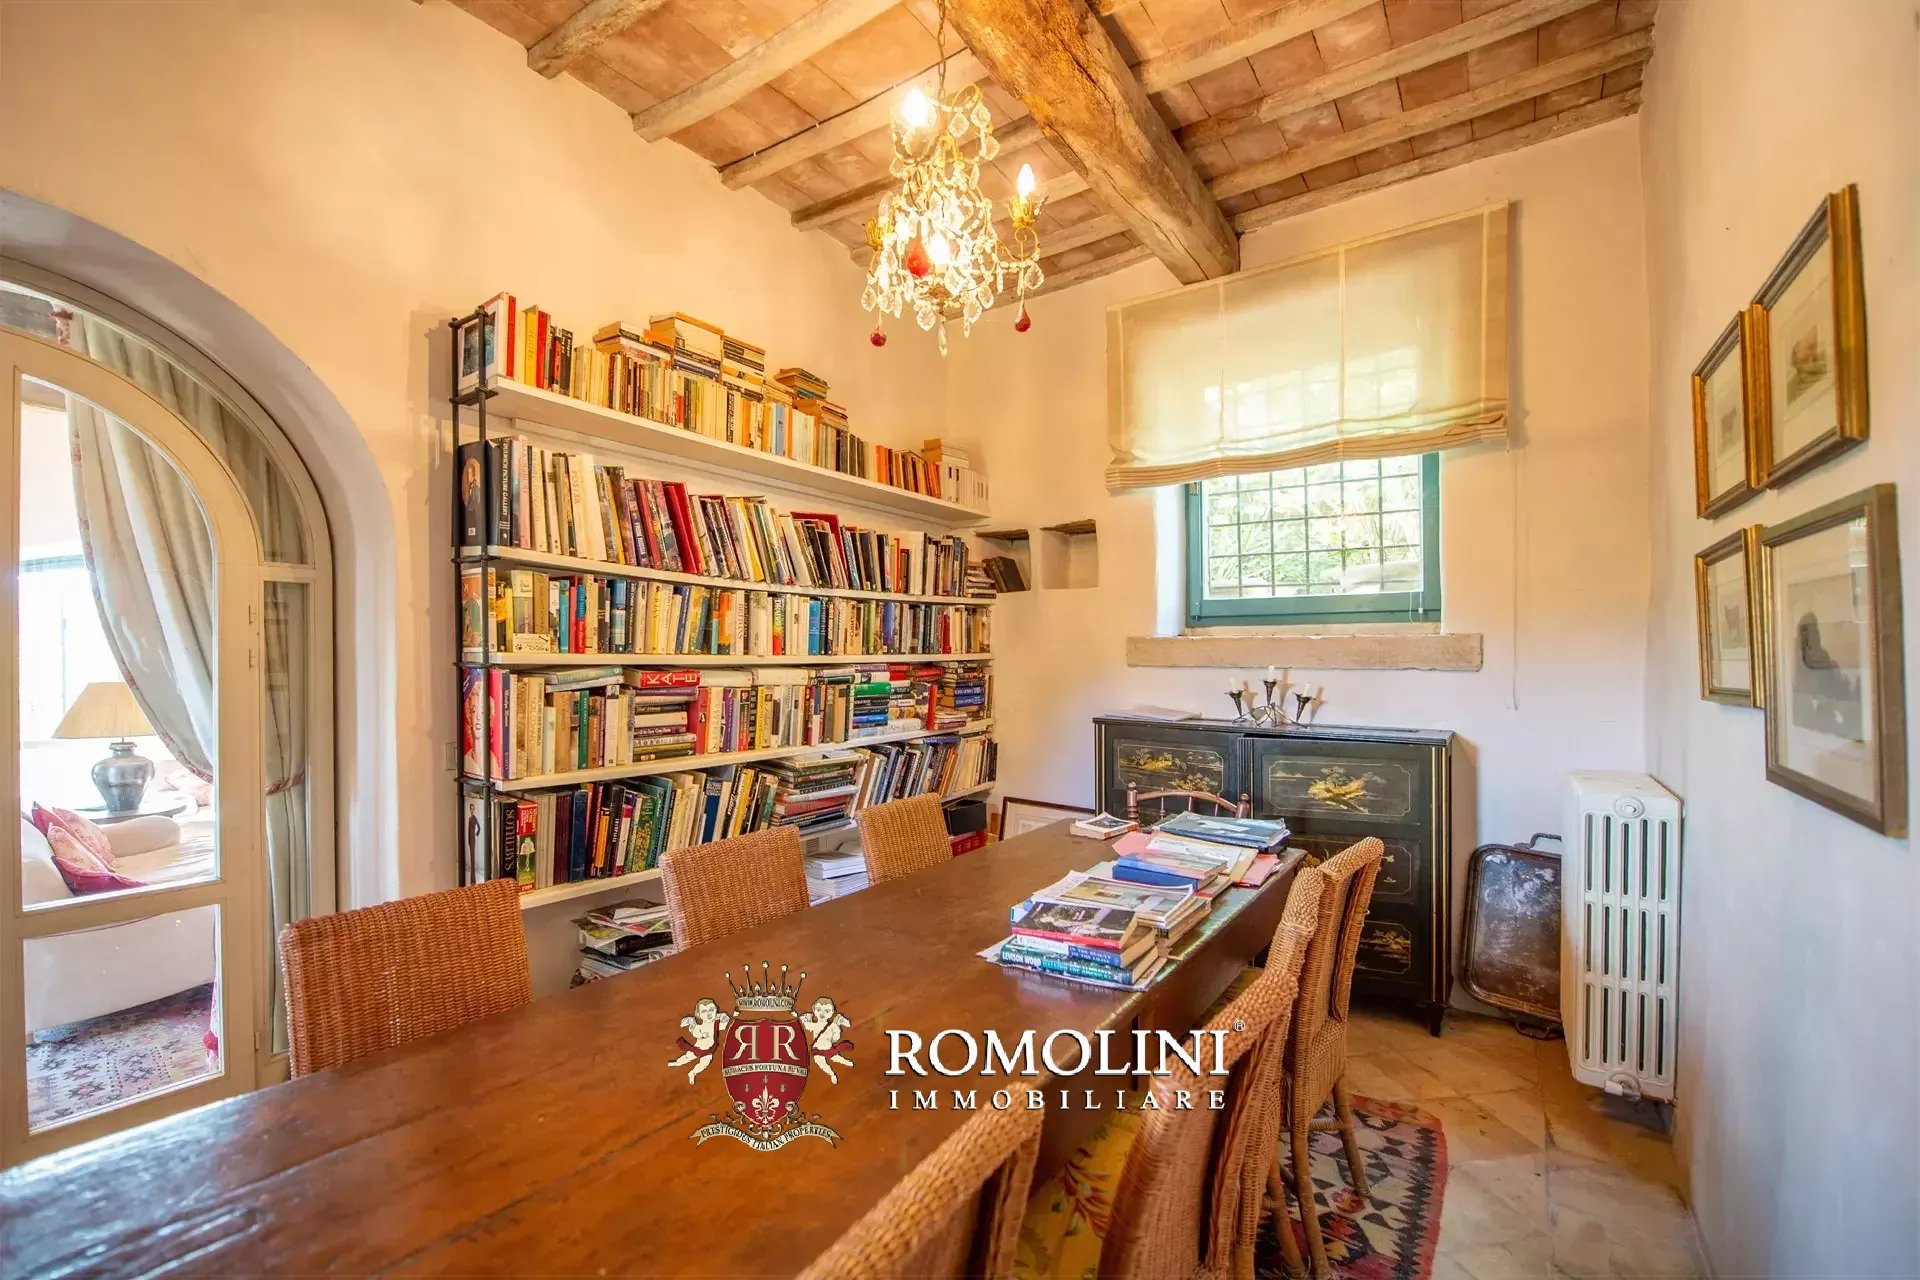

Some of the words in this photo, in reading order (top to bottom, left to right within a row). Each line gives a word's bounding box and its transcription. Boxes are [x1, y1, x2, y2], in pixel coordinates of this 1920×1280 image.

[647, 672, 697, 685] KATE
[505, 809, 516, 870] SOTHEBY'S
[1002, 951, 1024, 963] LEVISON
[1025, 956, 1041, 967] WOOD
